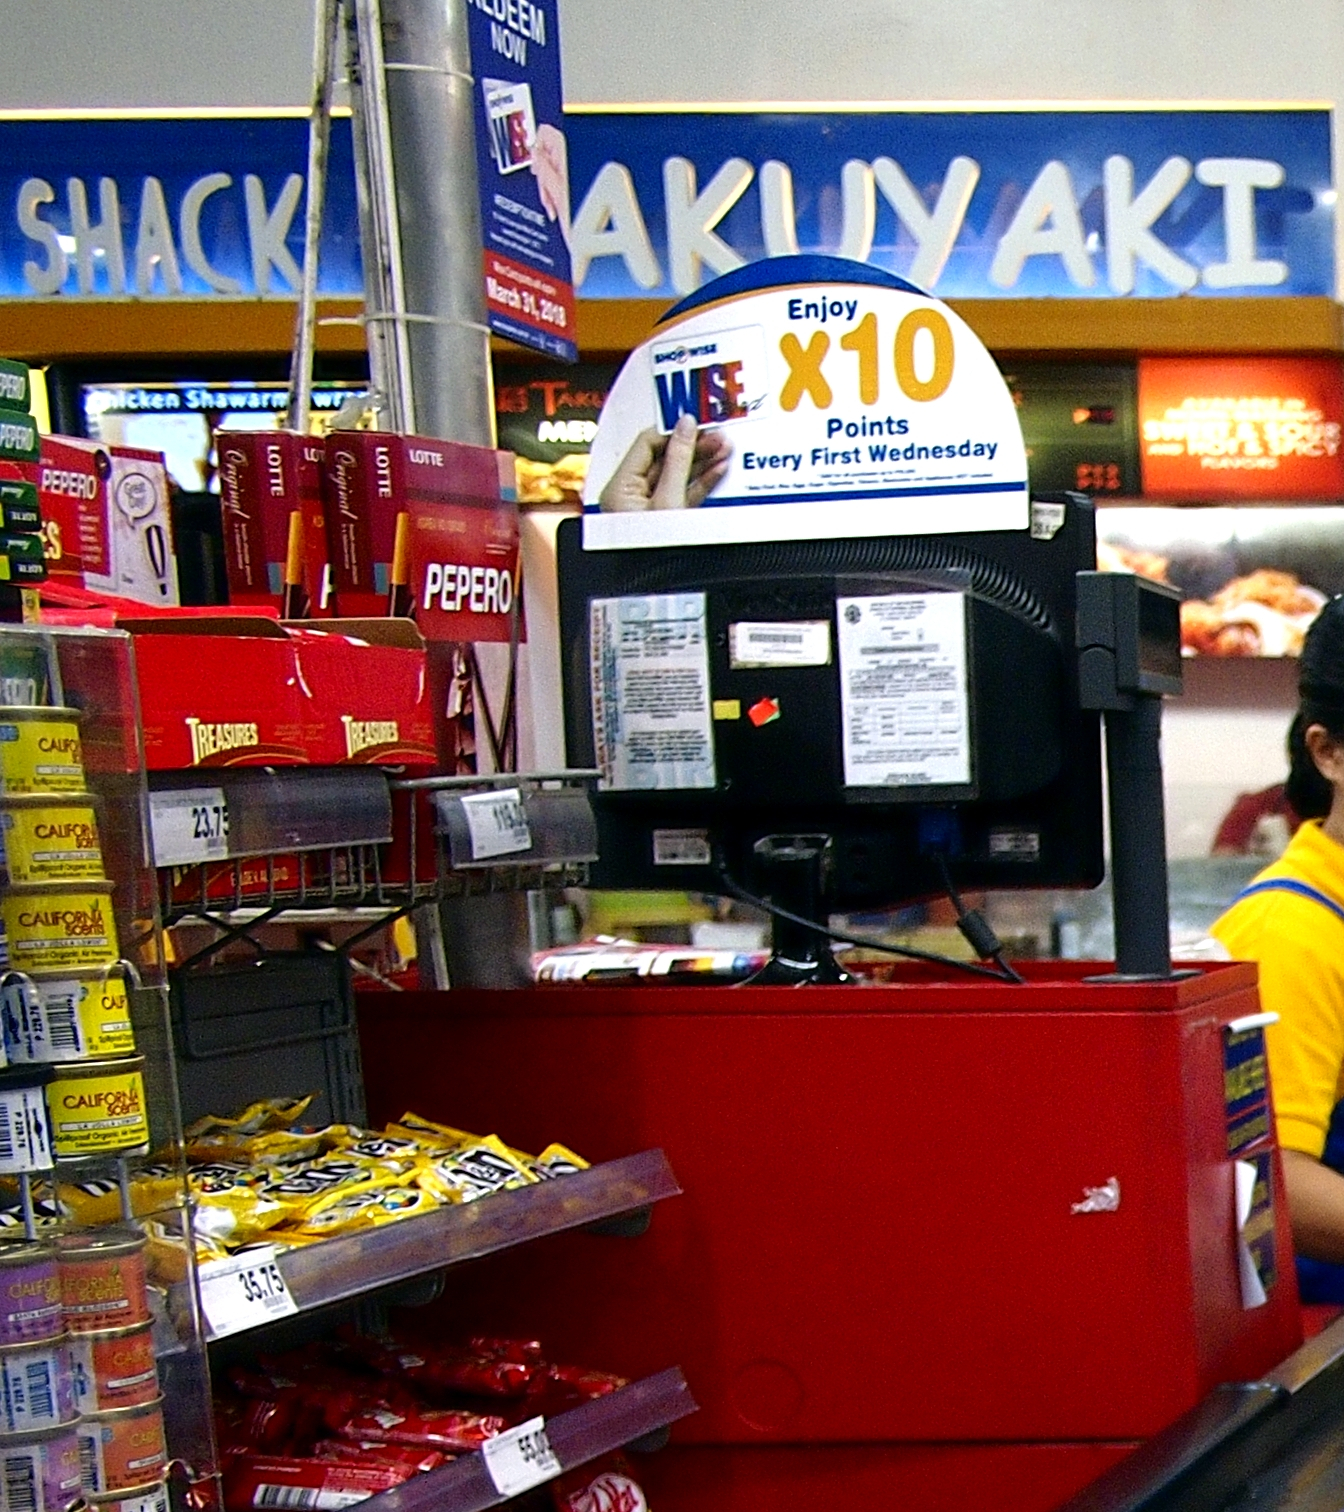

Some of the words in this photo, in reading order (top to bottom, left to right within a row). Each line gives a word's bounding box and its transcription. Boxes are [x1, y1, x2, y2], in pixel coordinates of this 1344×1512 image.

[469, 0, 545, 46] EDEEM
[491, 22, 526, 66] NOW
[17, 172, 303, 295] SHACK
[569, 155, 1288, 295] AKUYAKI
[788, 298, 857, 323] Enjoy
[88, 390, 181, 410] hicken
[185, 389, 290, 410] Shawarm
[654, 360, 747, 430] WISE
[826, 415, 910, 440] Points
[266, 445, 285, 497] LOTTE
[374, 446, 392, 498] LOTTE
[409, 448, 444, 467] LOTTE
[742, 452, 801, 472] Every
[811, 446, 861, 467] First
[868, 440, 999, 464] Wednesday
[42, 468, 97, 500] PEPERO
[423, 562, 514, 614] PEPERO
[185, 716, 260, 765] TREASURES
[341, 714, 399, 759] TREASURES
[63, 1088, 139, 1110] CALIFORNIA
[239, 1264, 285, 1302] 35.75
